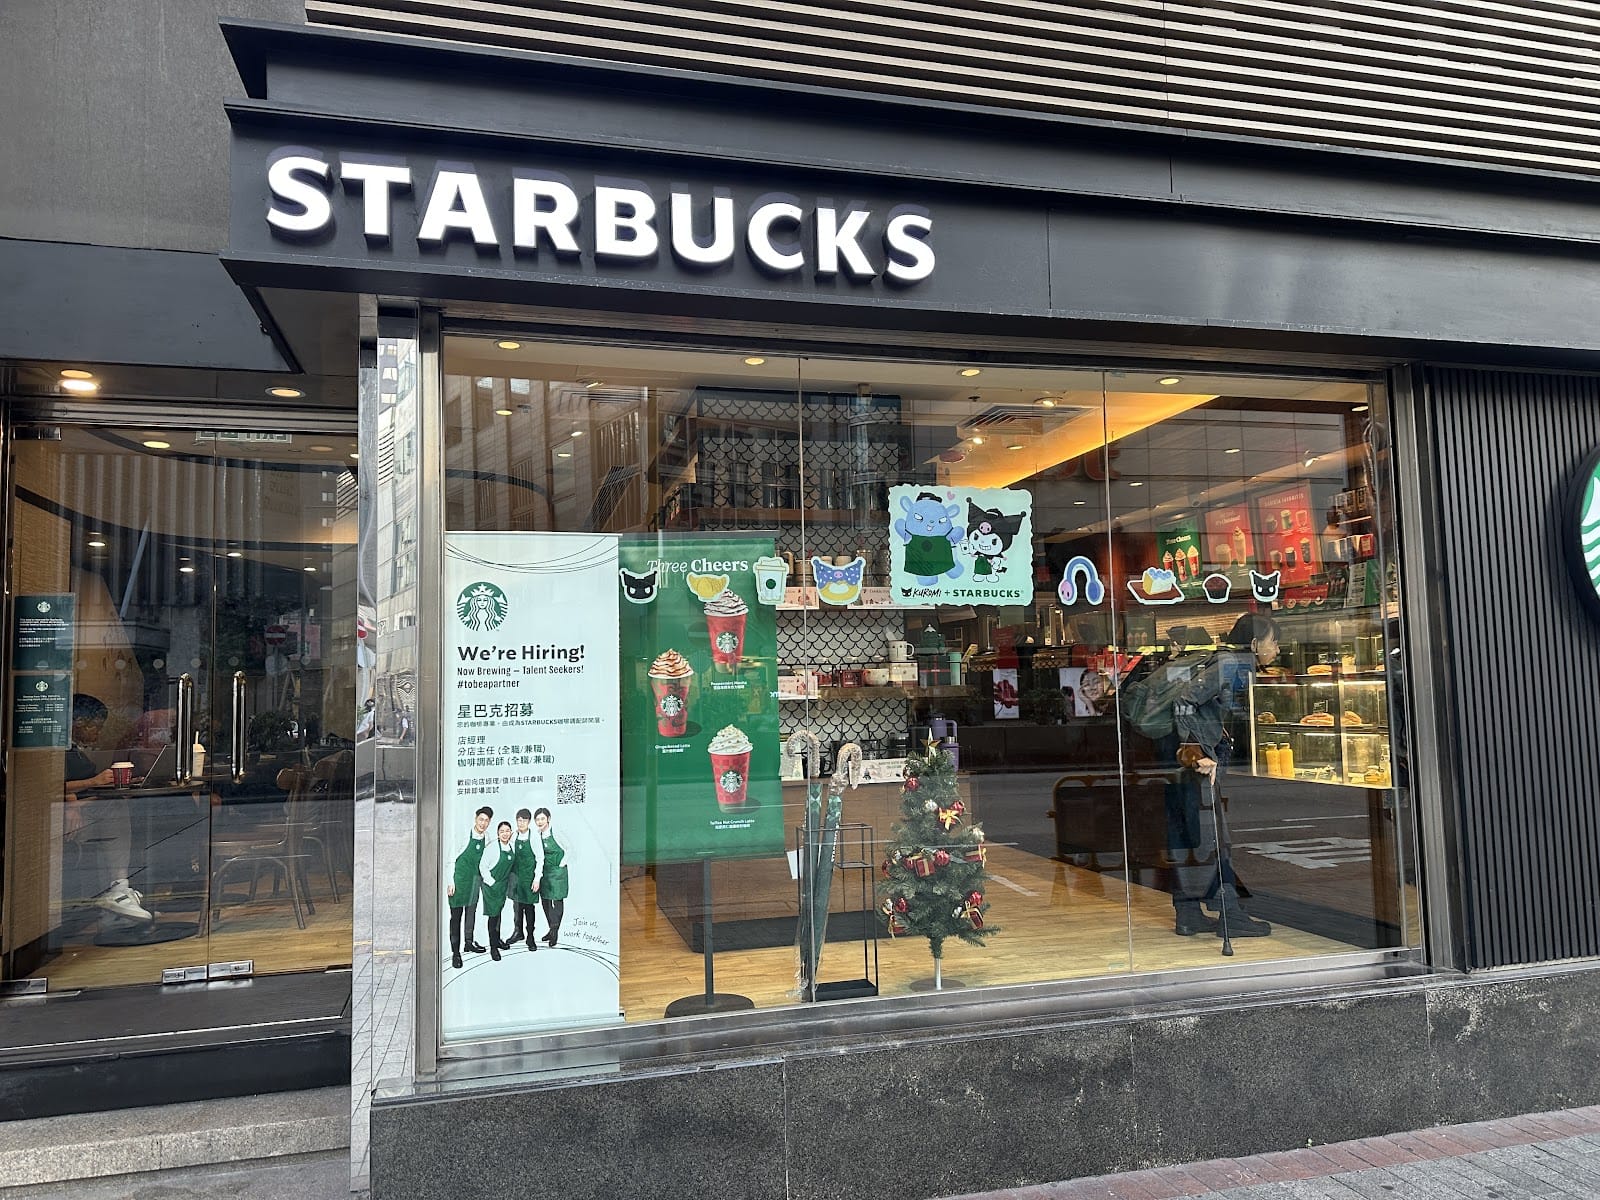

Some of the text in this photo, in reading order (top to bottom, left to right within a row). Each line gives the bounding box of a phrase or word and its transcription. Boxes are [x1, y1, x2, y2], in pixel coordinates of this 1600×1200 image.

[266, 156, 936, 283] STARBUCKS
[647, 558, 749, 573] Three Cheers
[953, 589, 1021, 598] STARBUCKS
[457, 644, 585, 663] We're Hiring!
[457, 667, 475, 676] Now
[477, 666, 511, 677] Brewing
[522, 665, 547, 675] Talent
[549, 664, 584, 674] Seekers!
[457, 679, 520, 690] #tobeapartner
[457, 702, 534, 719] 星巴克招募
[457, 735, 486, 745] 店經理
[457, 746, 495, 757] 分店主任
[457, 757, 505, 768] 咖啡調配師
[573, 917, 588, 927] Join
[563, 929, 610, 946] work together
